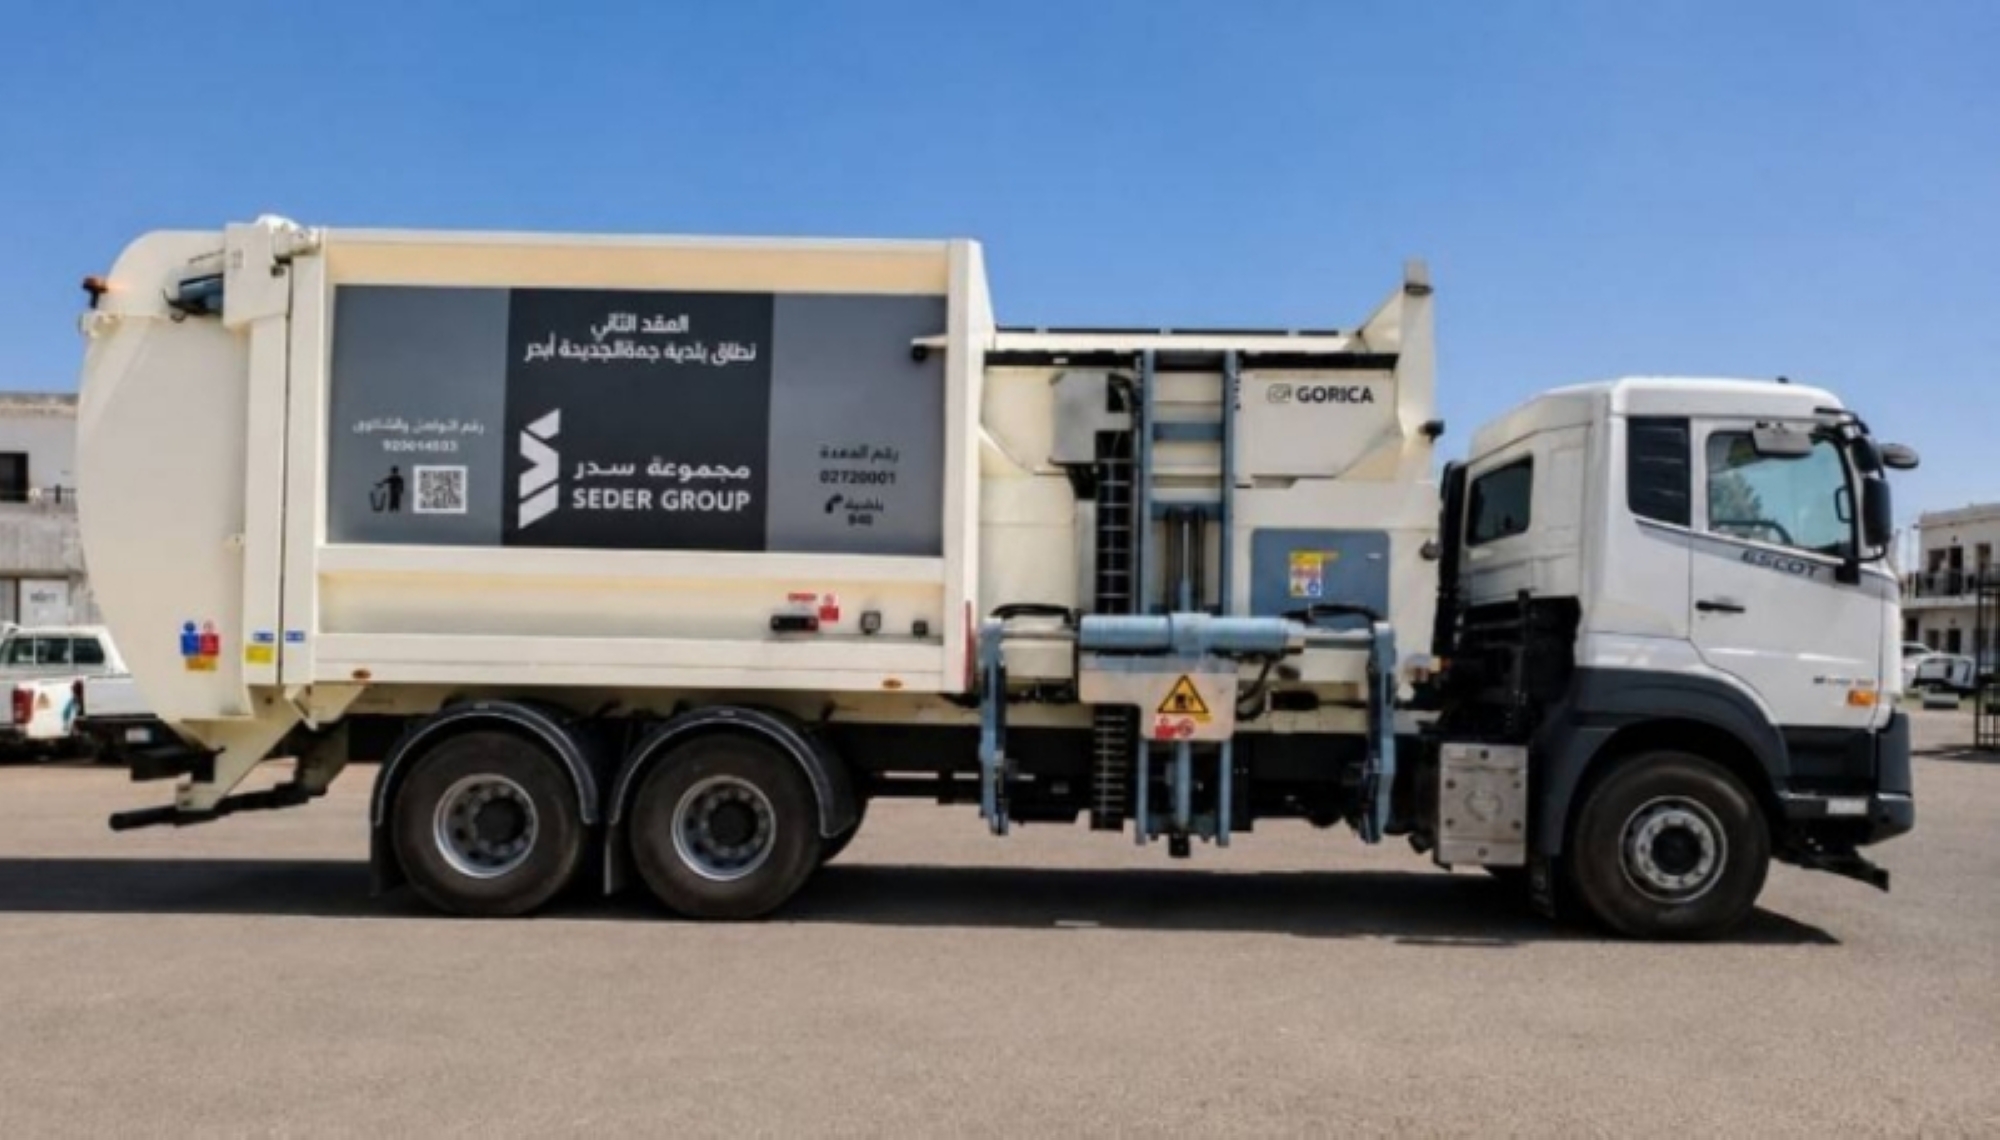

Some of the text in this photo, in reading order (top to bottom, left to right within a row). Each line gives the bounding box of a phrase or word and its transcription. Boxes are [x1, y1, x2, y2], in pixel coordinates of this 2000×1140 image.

[590, 311, 688, 342] العقد الثاني
[1296, 386, 1374, 403] GORICA
[573, 456, 751, 482] مجموعة سدر
[572, 488, 751, 511] SEDER GROUP
